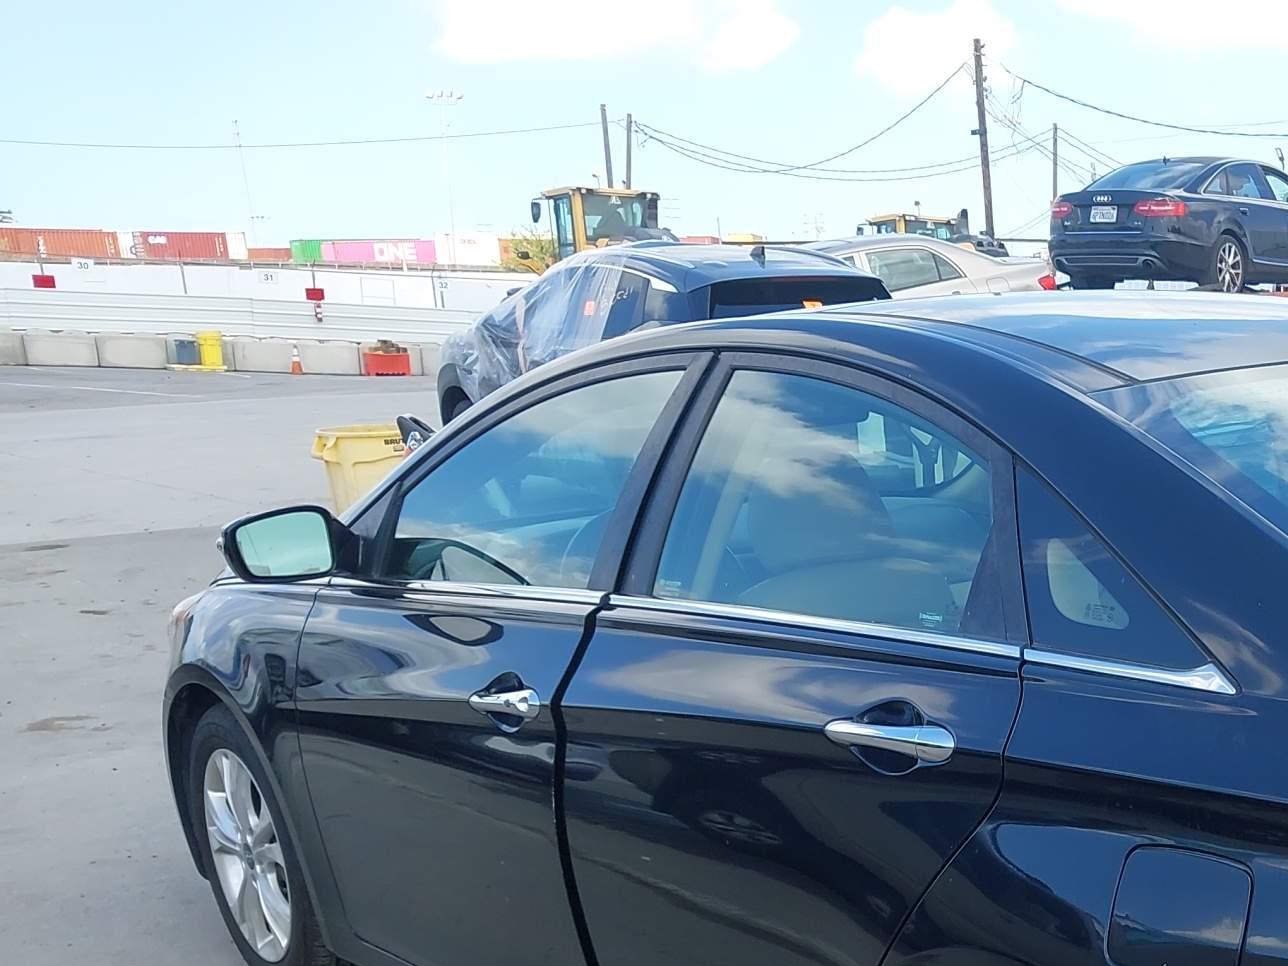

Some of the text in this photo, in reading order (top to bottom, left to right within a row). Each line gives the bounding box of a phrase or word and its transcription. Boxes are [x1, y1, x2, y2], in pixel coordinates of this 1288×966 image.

[373, 241, 417, 261] ONE
[77, 260, 89, 270] 30
[263, 273, 274, 282] 31
[438, 281, 449, 290] 32
